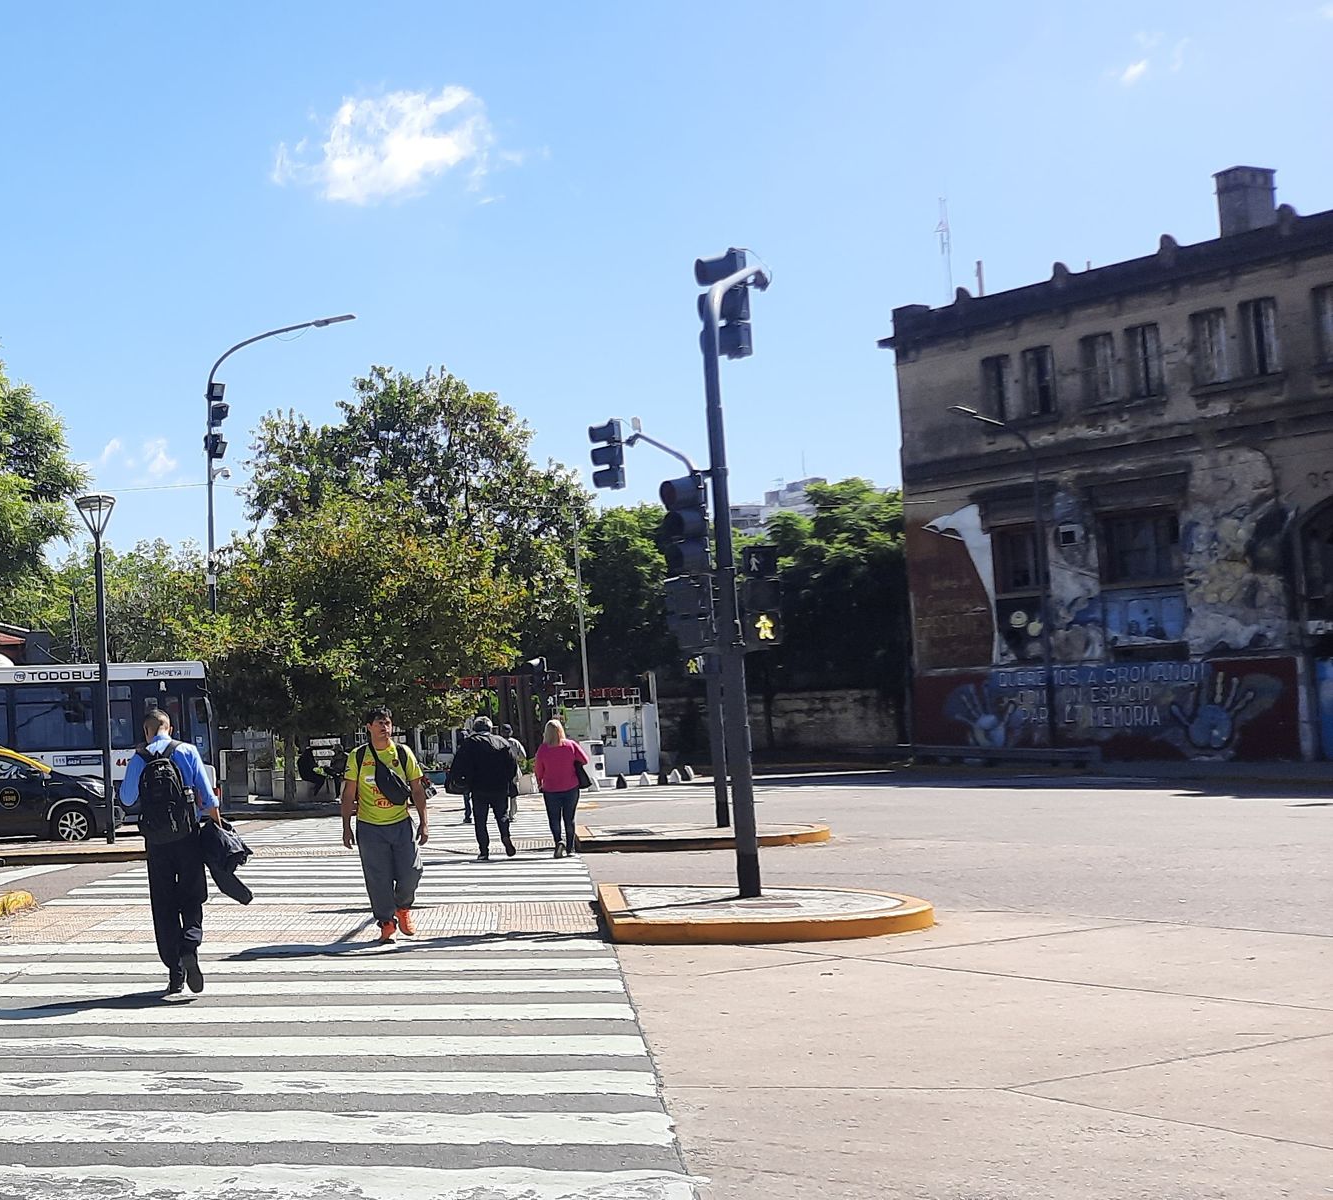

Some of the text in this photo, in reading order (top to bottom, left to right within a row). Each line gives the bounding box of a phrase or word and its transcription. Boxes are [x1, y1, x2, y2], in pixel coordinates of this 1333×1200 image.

[1088, 671, 1097, 684] A
[1090, 686, 1152, 703] ESPACIO
[1089, 705, 1161, 727] MEMORIA
